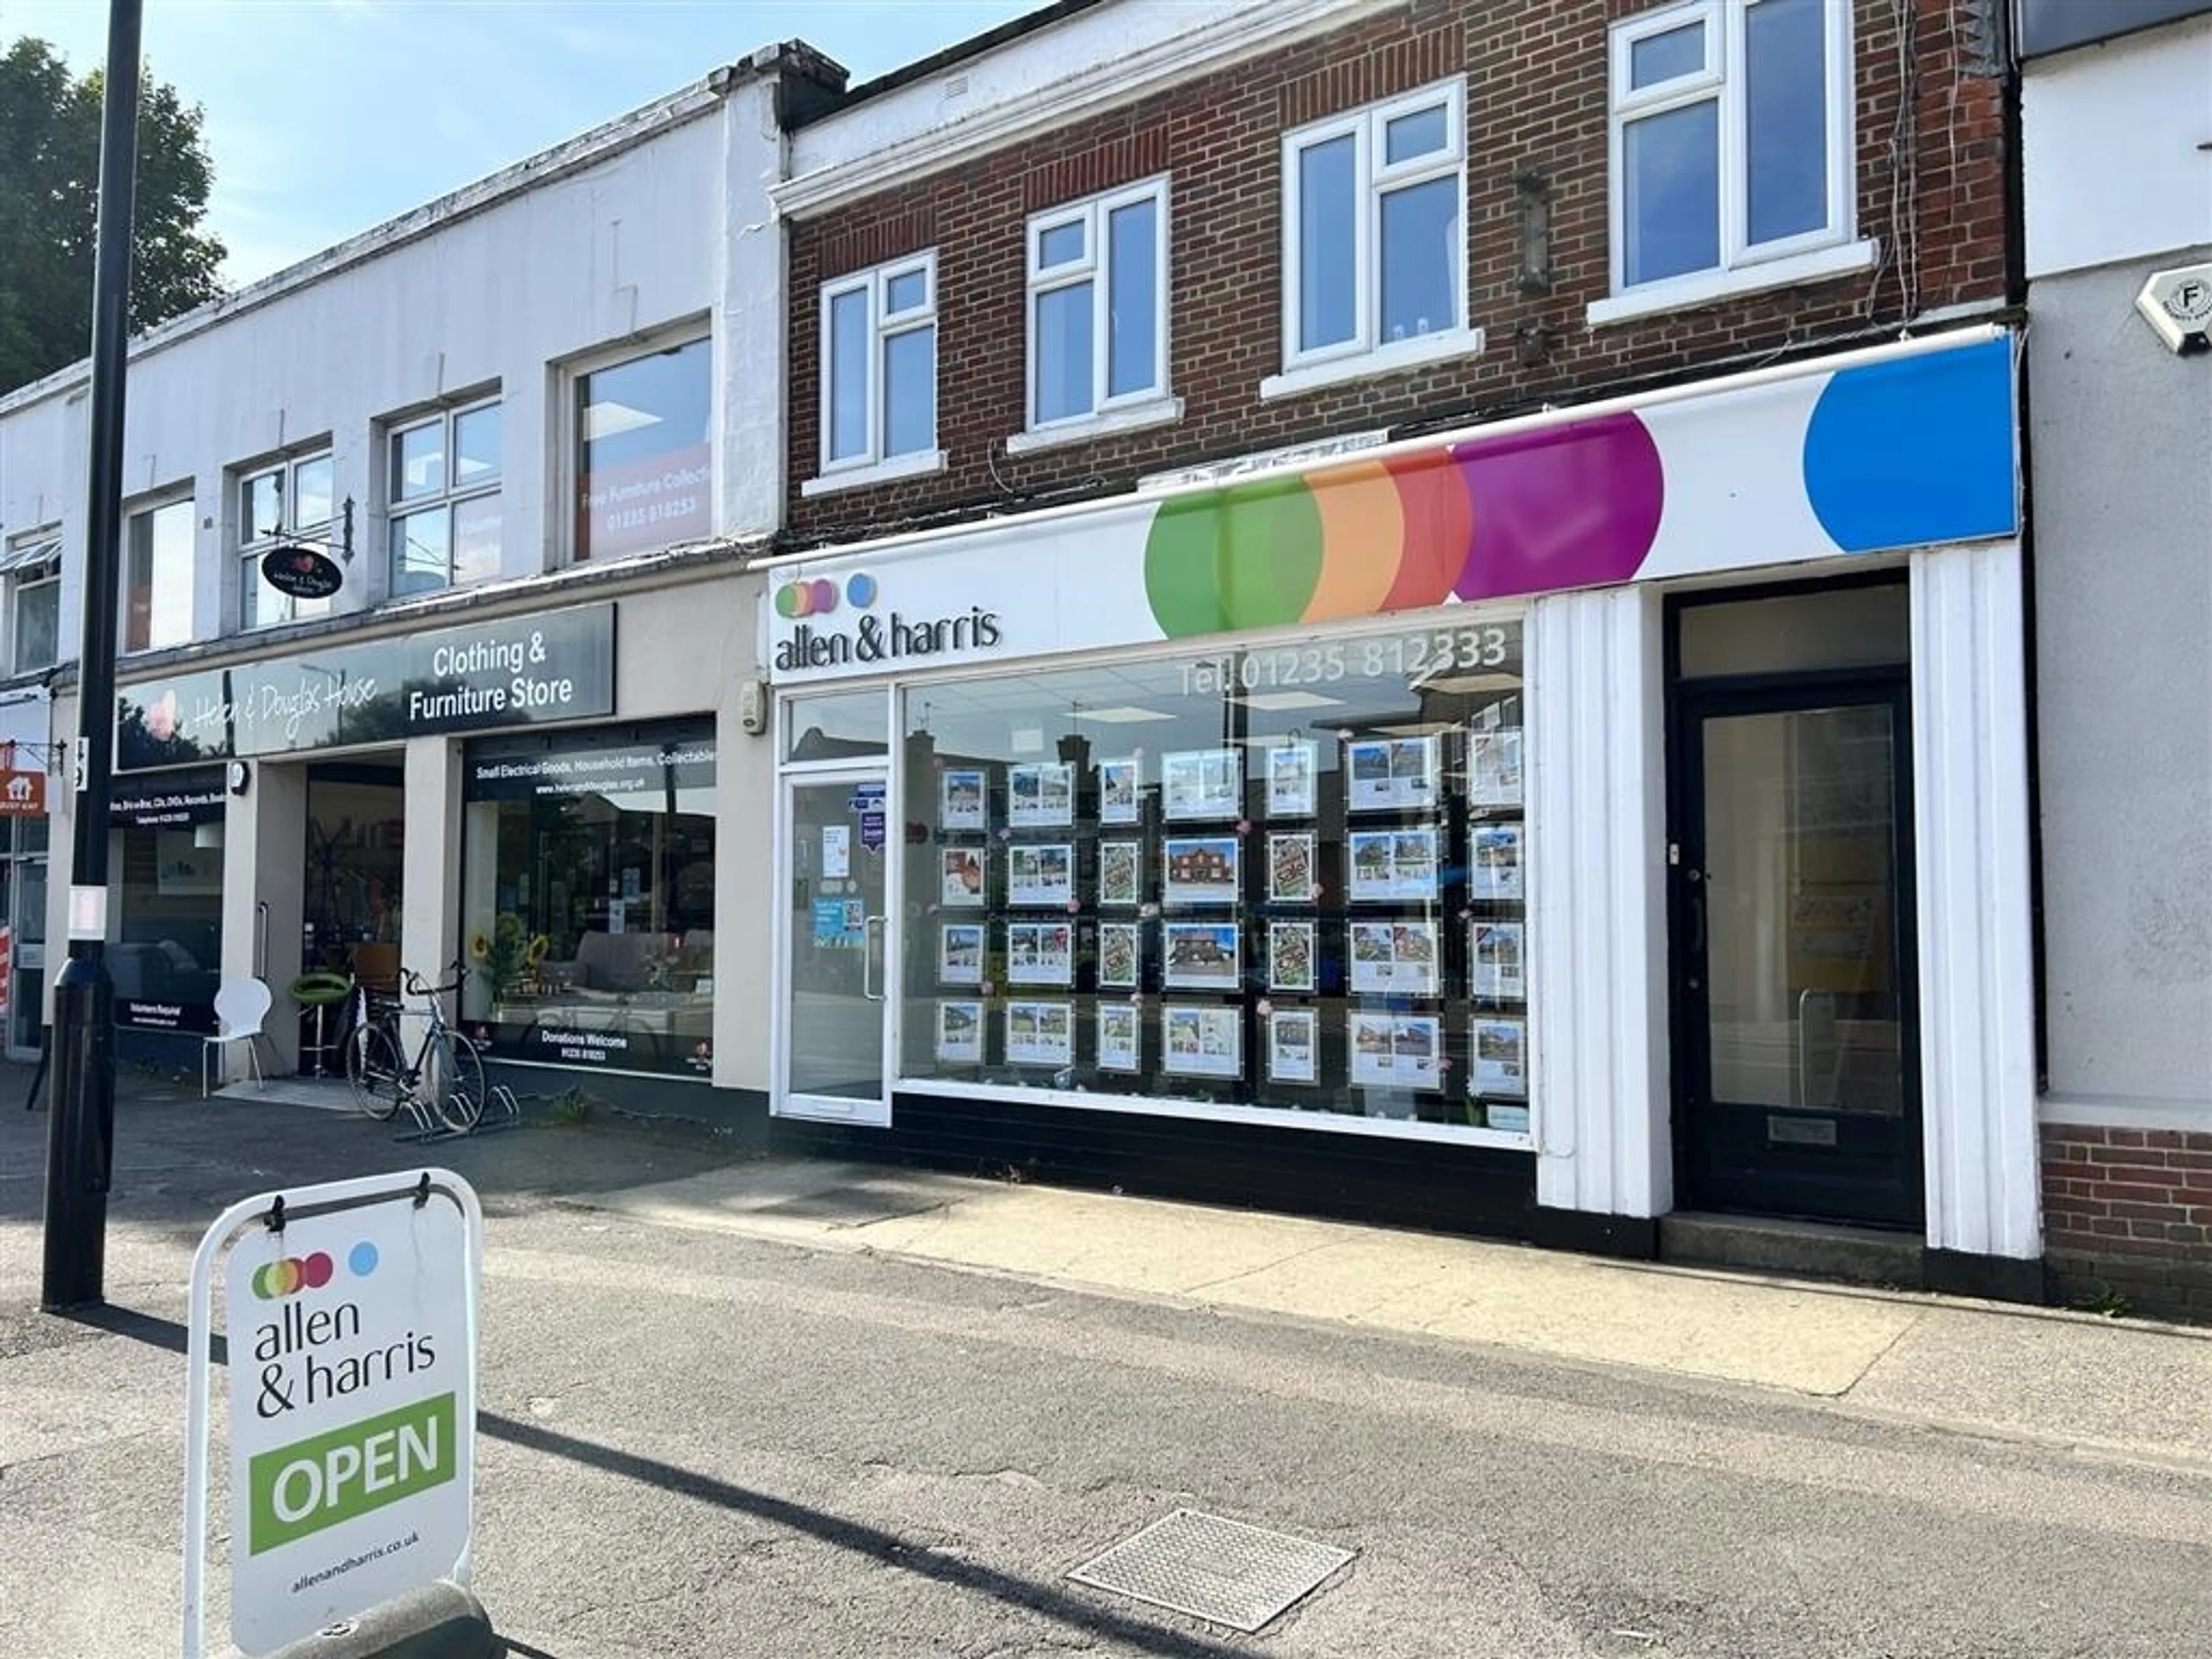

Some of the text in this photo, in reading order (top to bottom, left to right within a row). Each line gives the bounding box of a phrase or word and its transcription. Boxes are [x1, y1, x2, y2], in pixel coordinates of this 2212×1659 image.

[434, 631, 546, 677] Clothing &
[776, 606, 999, 671] allen & harris
[1240, 646, 1345, 688] 01235
[1363, 629, 1506, 677] 812333
[260, 676, 321, 740] Douglas
[324, 672, 378, 710] House
[410, 677, 573, 721] Furniture Store
[255, 1301, 359, 1361] allen
[257, 1331, 435, 1418] & harris
[272, 1415, 438, 1524] OPEN
[291, 1531, 419, 1593] allenandharris.co.uk
